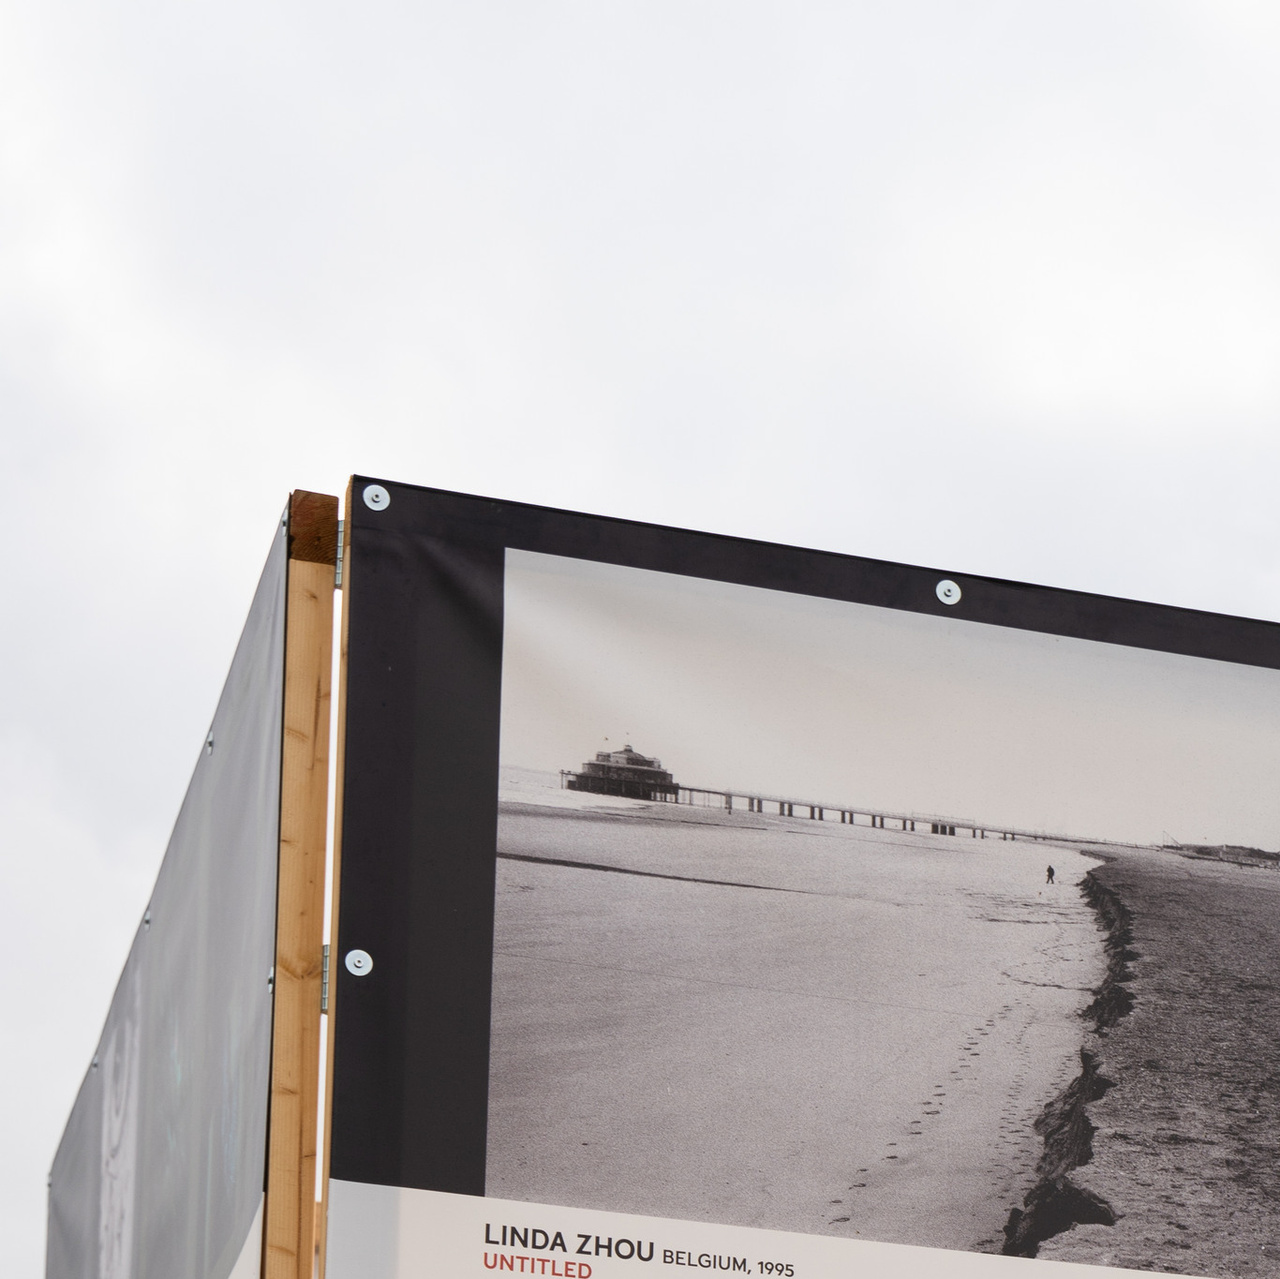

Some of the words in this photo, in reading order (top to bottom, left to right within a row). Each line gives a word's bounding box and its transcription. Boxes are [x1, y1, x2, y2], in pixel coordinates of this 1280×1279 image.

[483, 1251, 593, 1279] UNTITLED
[484, 1222, 568, 1253] LINDA
[575, 1233, 655, 1262] ZHOU
[662, 1249, 752, 1275] BELGIUM,
[757, 1260, 795, 1278] 1995
